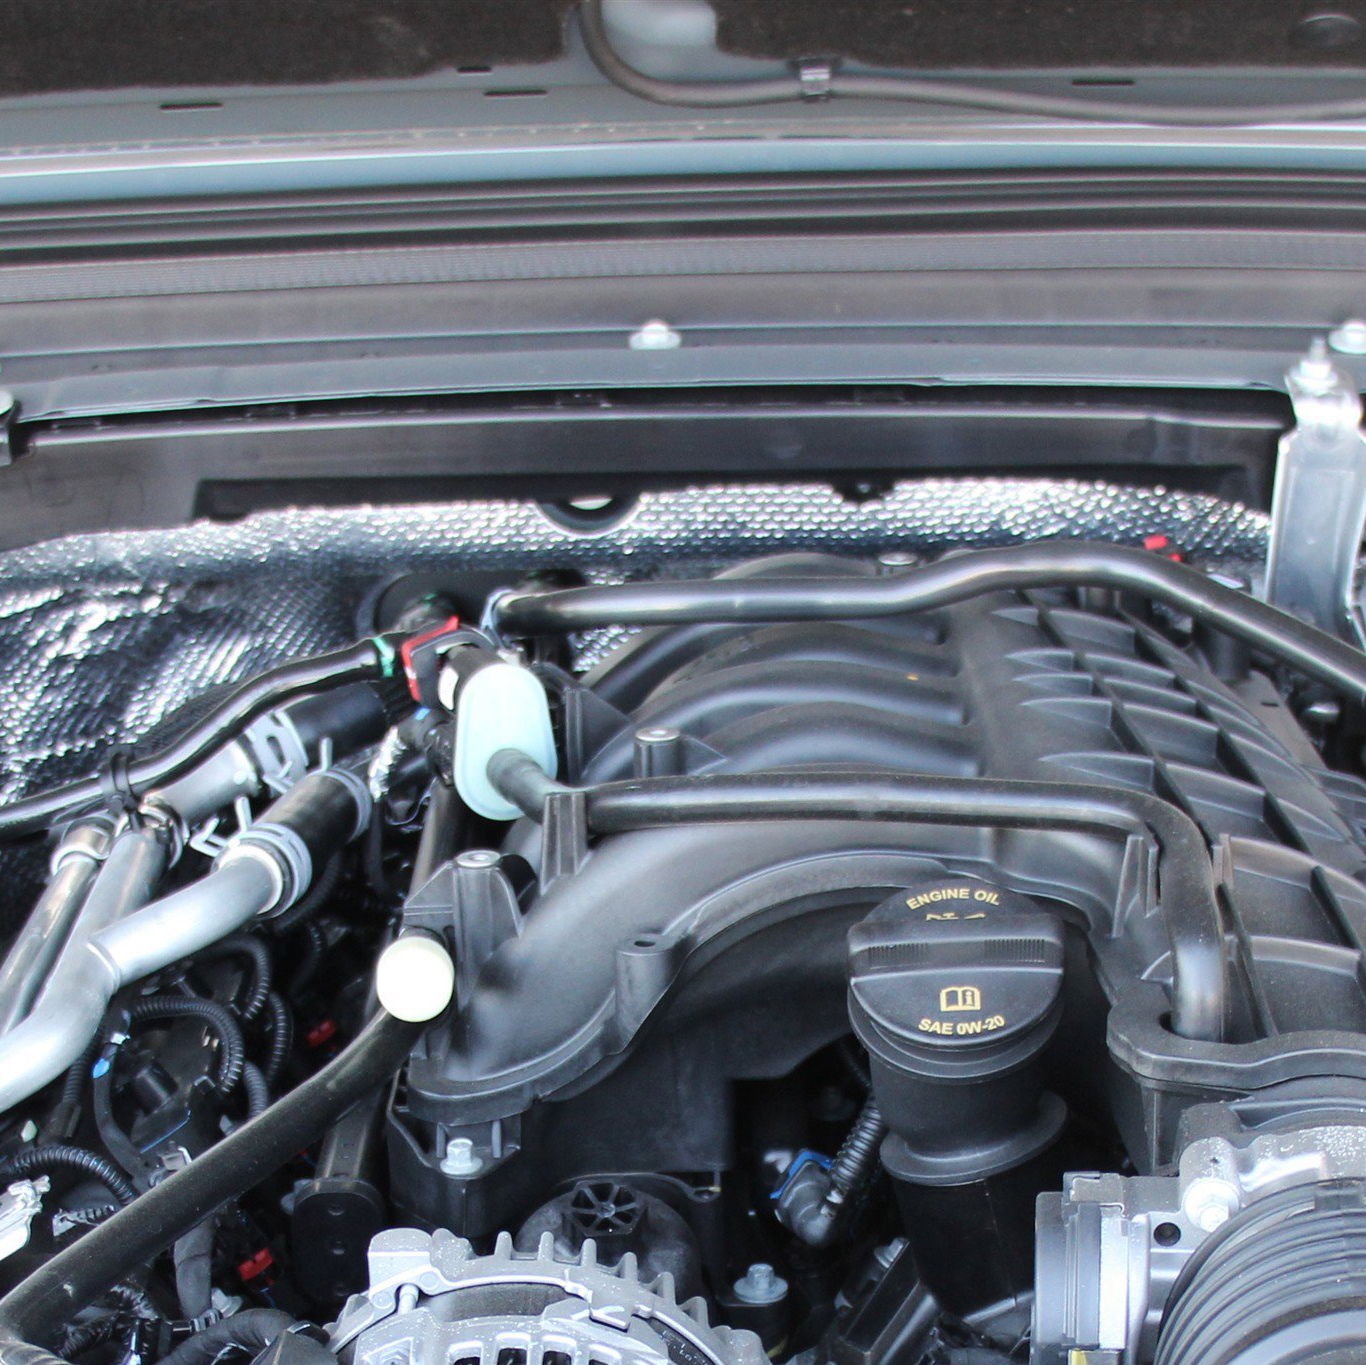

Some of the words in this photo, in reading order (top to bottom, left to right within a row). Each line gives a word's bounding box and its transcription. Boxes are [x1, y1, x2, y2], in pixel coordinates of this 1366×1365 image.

[906, 888, 969, 911] ENGINE
[973, 889, 1001, 906] OIL
[918, 1018, 953, 1035] SAE
[956, 1014, 1005, 1035] 0W-20
